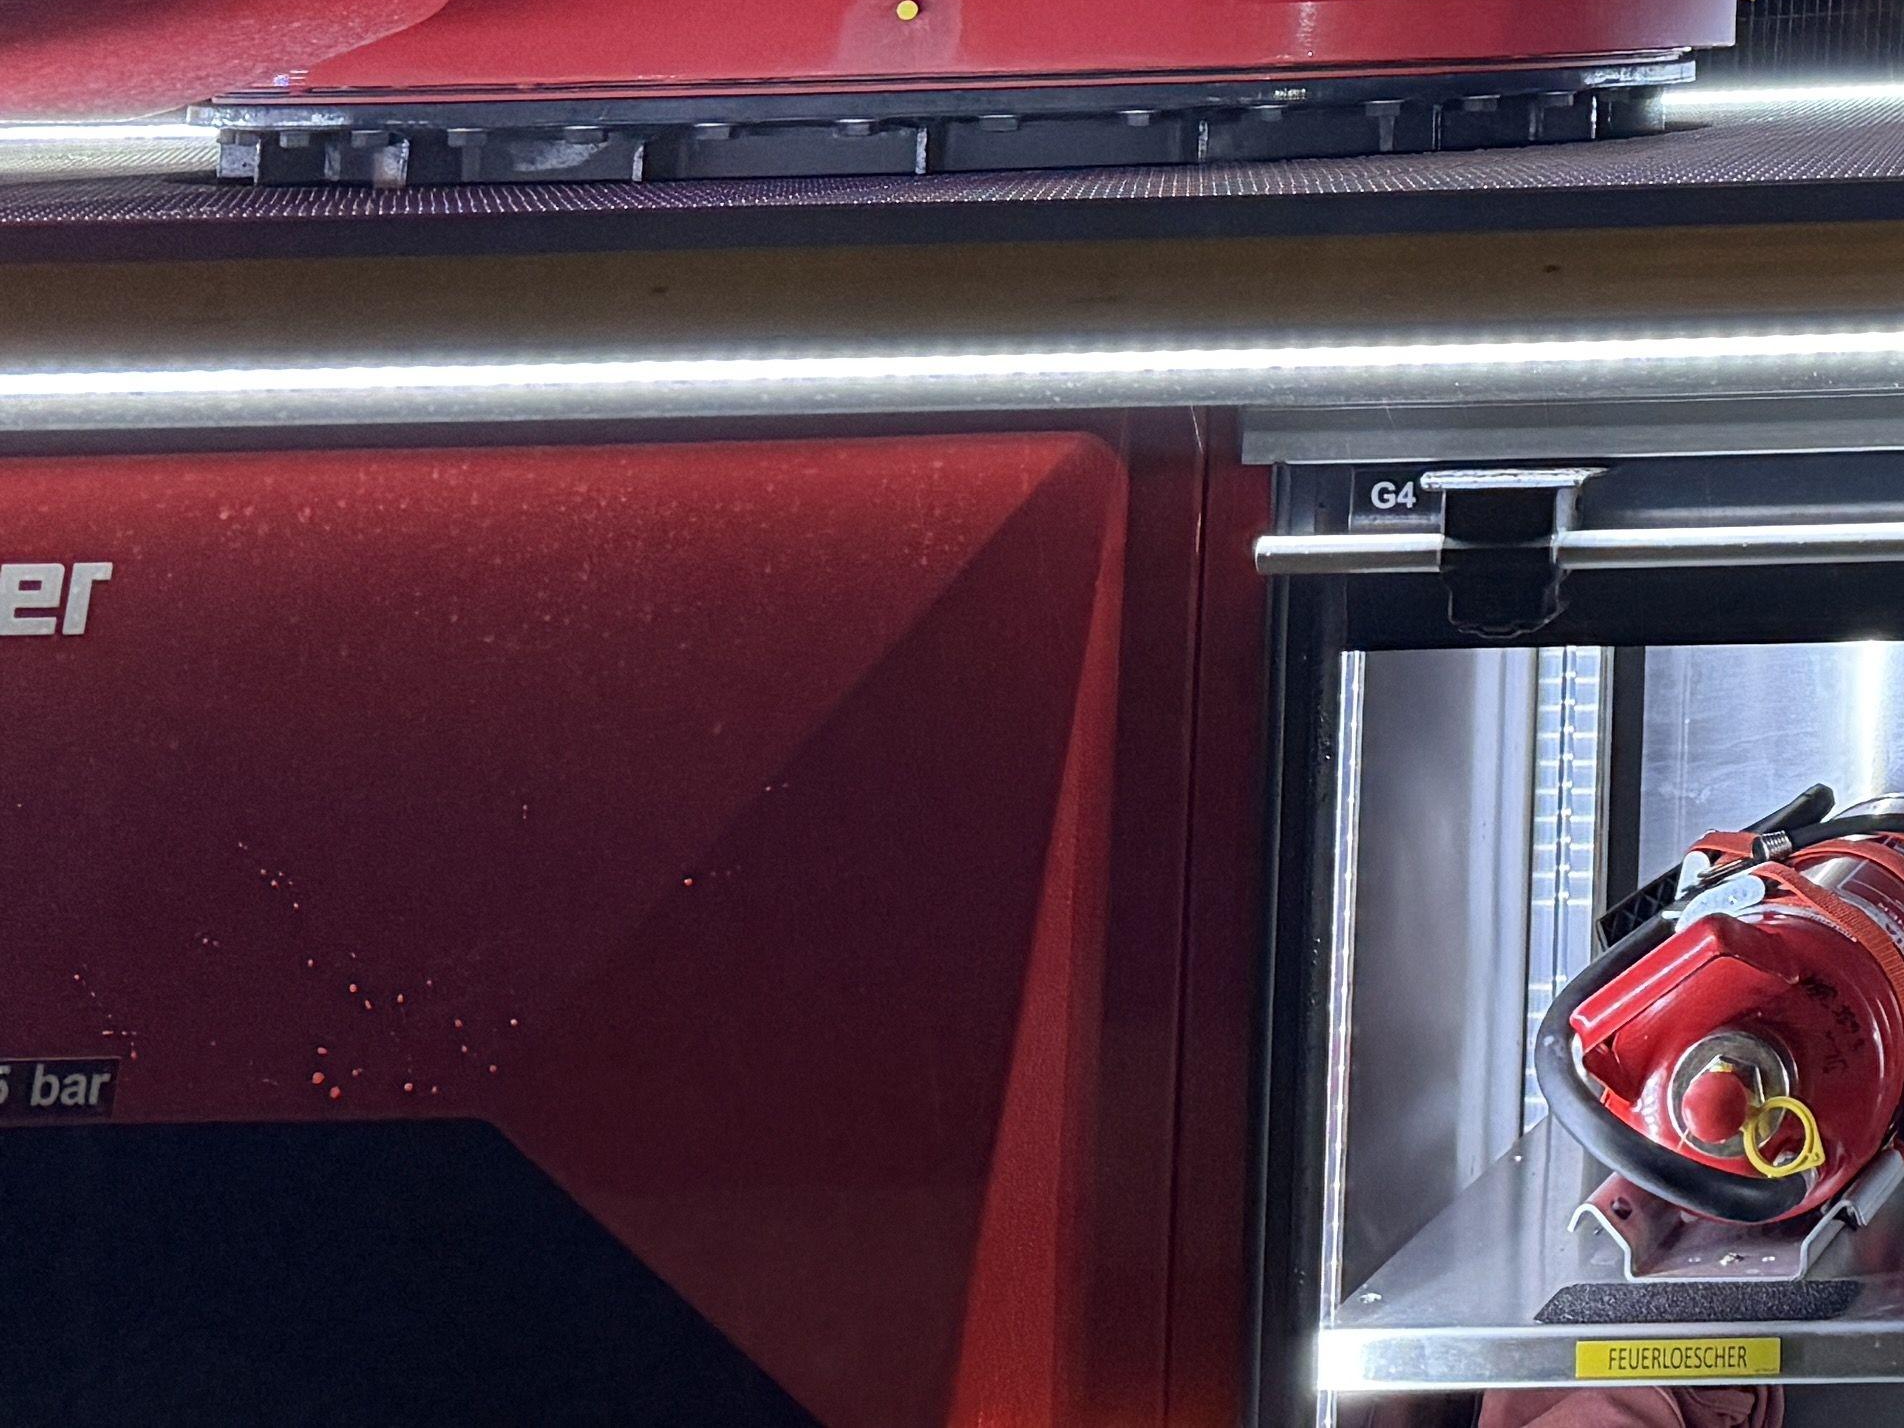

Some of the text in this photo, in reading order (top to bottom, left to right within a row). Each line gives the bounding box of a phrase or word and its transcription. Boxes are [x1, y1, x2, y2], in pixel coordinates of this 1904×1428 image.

[1370, 480, 1417, 509] G4
[0, 561, 114, 636] er
[30, 1063, 111, 1106] bar
[1608, 1346, 1748, 1370] FEUERLOESCHER
